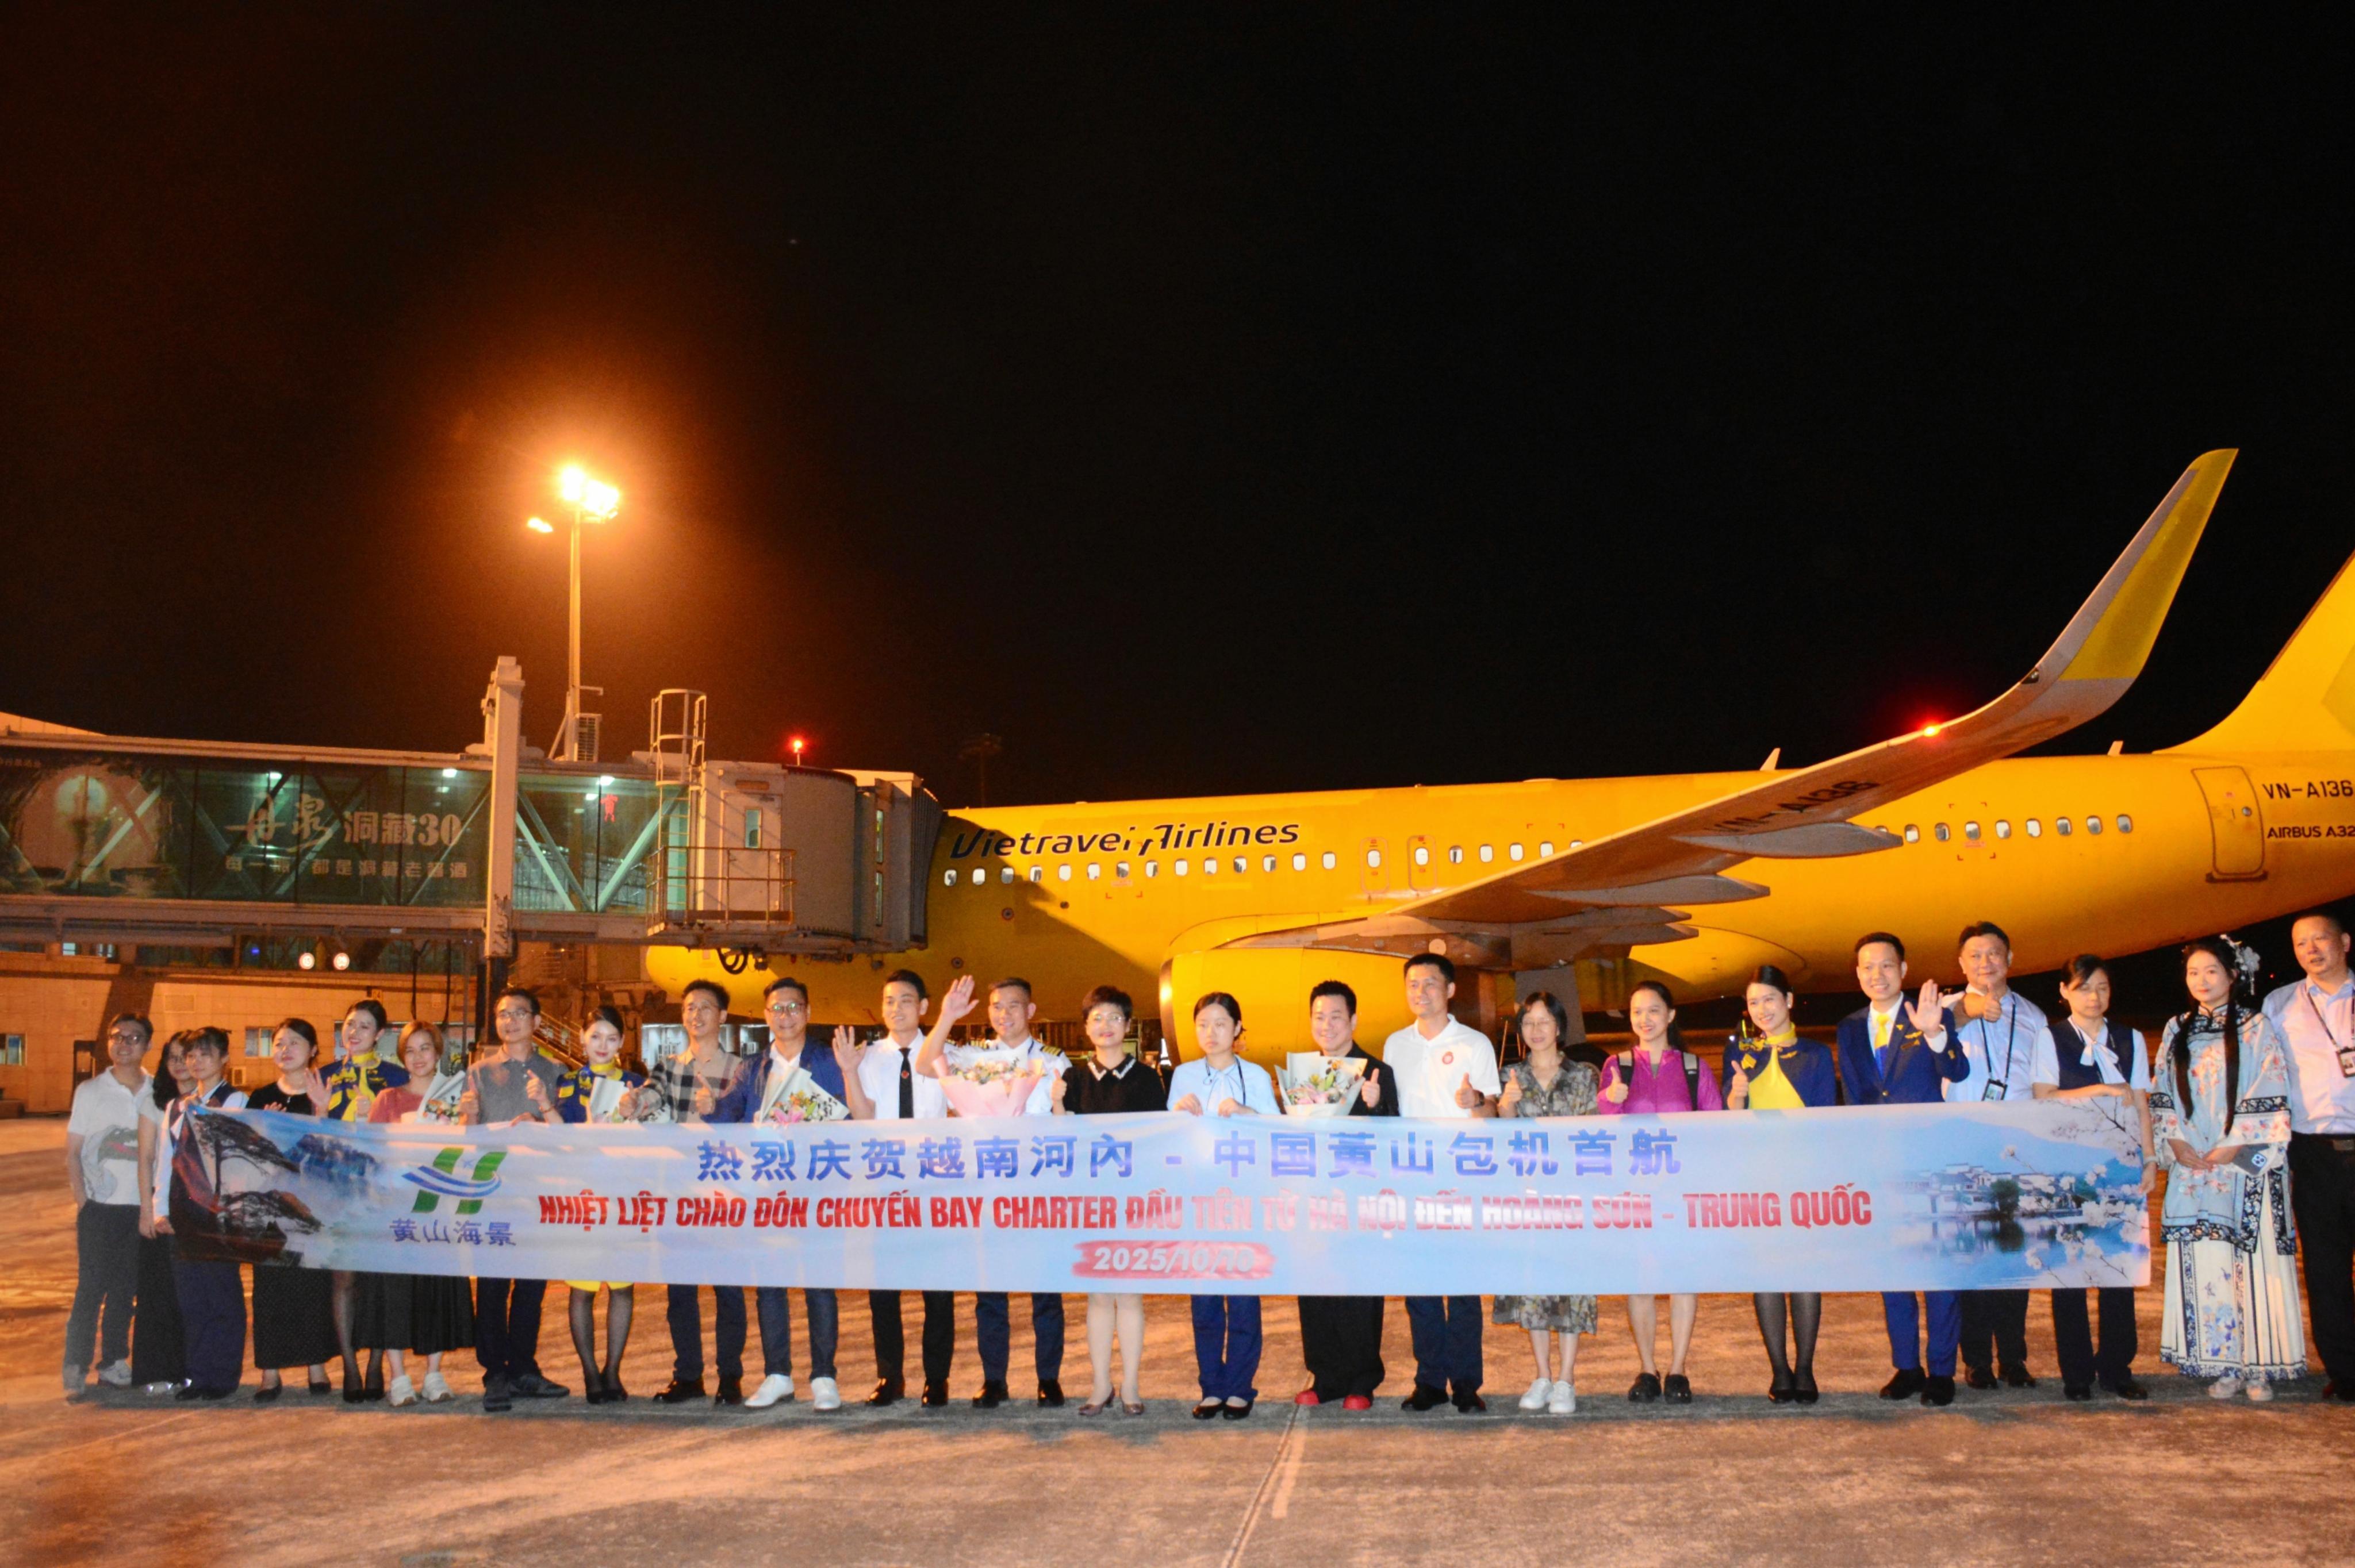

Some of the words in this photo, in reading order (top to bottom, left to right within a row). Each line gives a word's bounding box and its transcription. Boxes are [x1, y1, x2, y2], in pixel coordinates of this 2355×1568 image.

[2262, 780, 2354, 799] VN-A136
[1138, 821, 1300, 857] Airlines
[2267, 826, 2322, 839] AIRBUS
[538, 1188, 609, 1232] NHIỆT
[617, 1190, 668, 1232] LIỆT
[676, 1190, 747, 1228] CHÀO
[754, 1190, 808, 1228] ĐÓN
[816, 1189, 921, 1228] CHUYẾN
[930, 1196, 983, 1228] BAY
[994, 1195, 1117, 1229] CHARTER
[1125, 1187, 1183, 1229] ĐẦU
[1191, 1186, 1253, 1231] TIÊN
[1309, 1187, 1349, 1231] HÀ
[1357, 1187, 1406, 1239] NỘI
[1414, 1187, 1472, 1230] ĐẾN
[1482, 1188, 1584, 1230] HOÀNG
[1682, 1192, 1781, 1228] TRUNG
[1791, 1182, 1873, 1229] QUỐC
[1093, 1246, 1256, 1274] 2025/10/10
